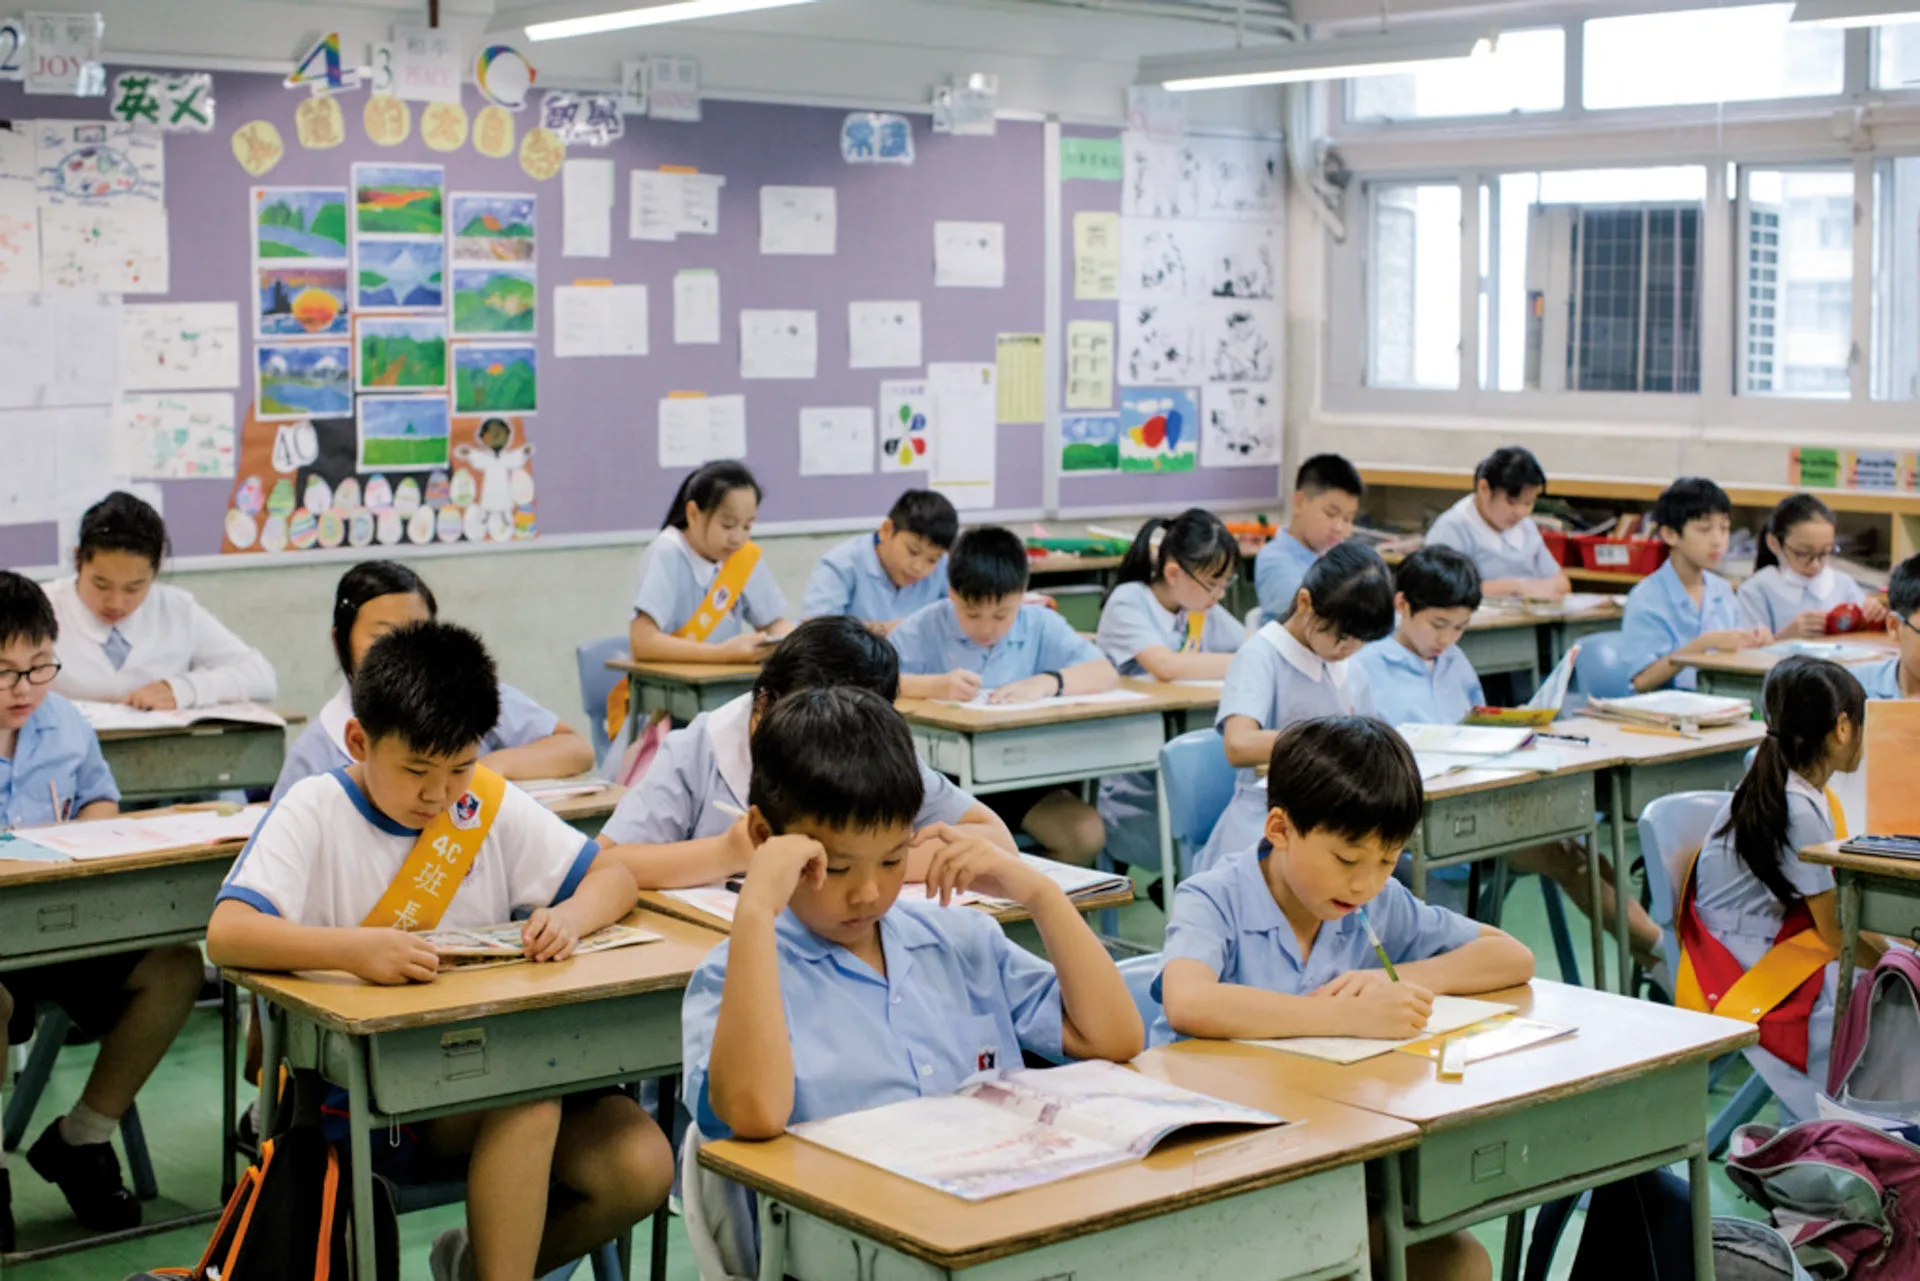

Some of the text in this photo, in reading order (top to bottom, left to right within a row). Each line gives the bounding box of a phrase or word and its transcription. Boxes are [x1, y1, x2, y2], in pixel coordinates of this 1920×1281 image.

[0, 25, 19, 72] 2
[287, 32, 536, 107] 4 C
[375, 47, 392, 90] 3
[115, 76, 208, 124] 英文
[626, 68, 644, 105] 4
[392, 834, 462, 931] 4C 班長
